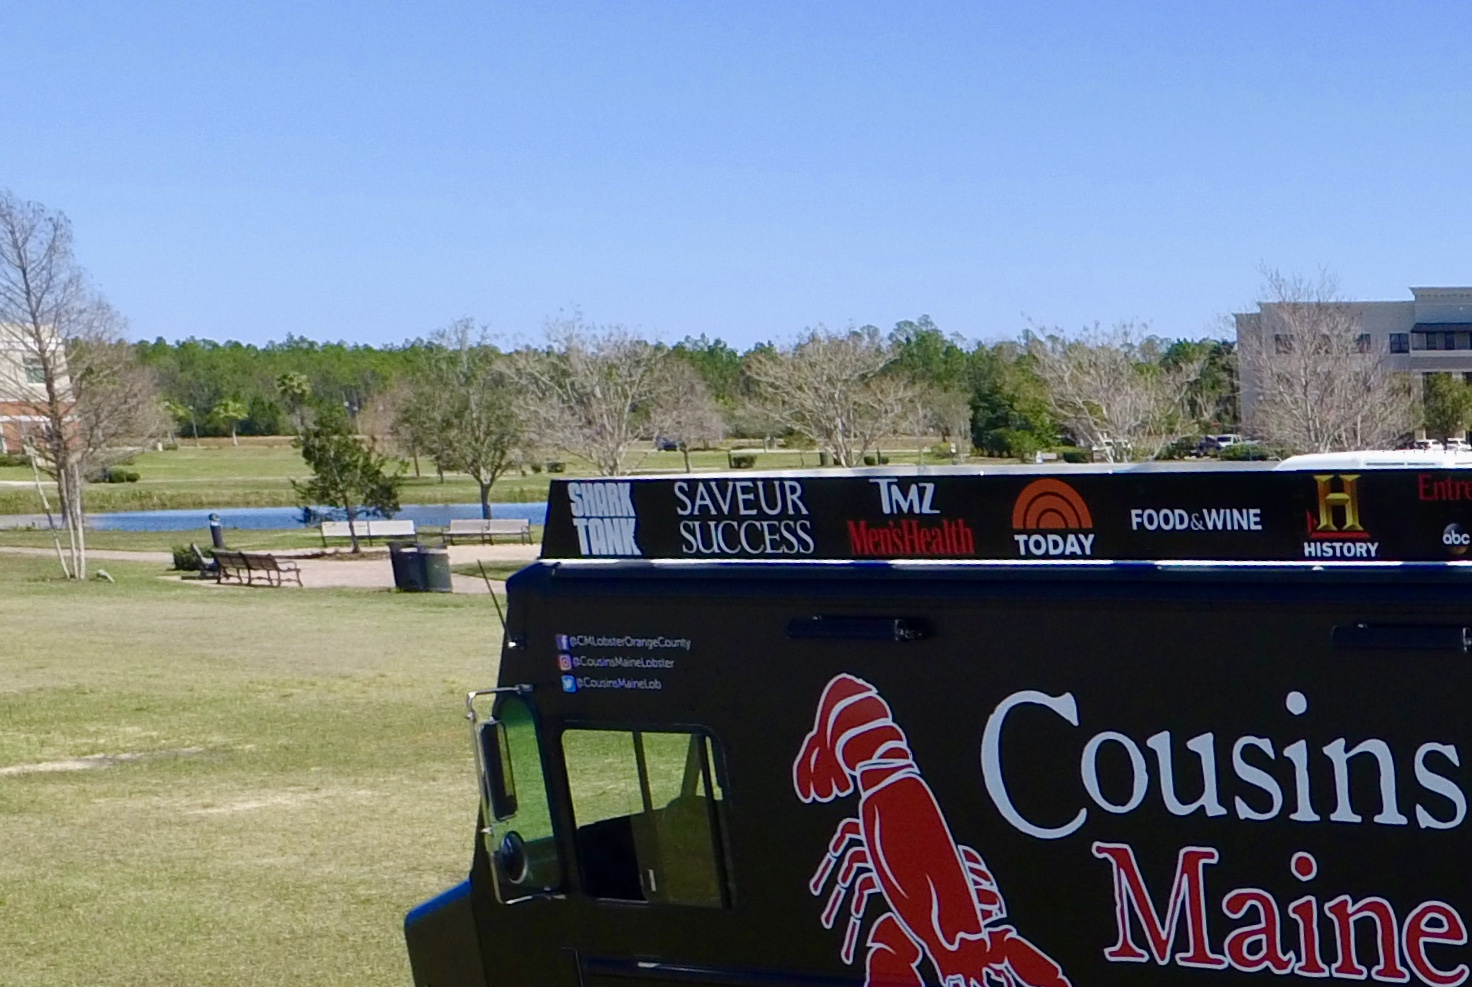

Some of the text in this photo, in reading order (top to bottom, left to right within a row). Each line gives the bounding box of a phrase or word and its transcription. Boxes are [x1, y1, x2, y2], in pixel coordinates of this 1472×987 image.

[567, 482, 636, 517] SHARK
[673, 481, 809, 516] SAVEUR
[868, 478, 941, 515] TMZ
[572, 517, 642, 555] TANK
[679, 520, 815, 554] SUCCESS
[1014, 534, 1095, 556] TODAY
[1304, 542, 1379, 558] HISTORY
[1442, 530, 1471, 545] abc
[570, 635, 691, 650] @CMLobsterOrangeCounty
[573, 656, 675, 669] @CousinsMaineLobster
[577, 677, 662, 690] @CousinsMaineLob
[981, 690, 1467, 839] Cousins
[1092, 841, 1470, 987] Maine
